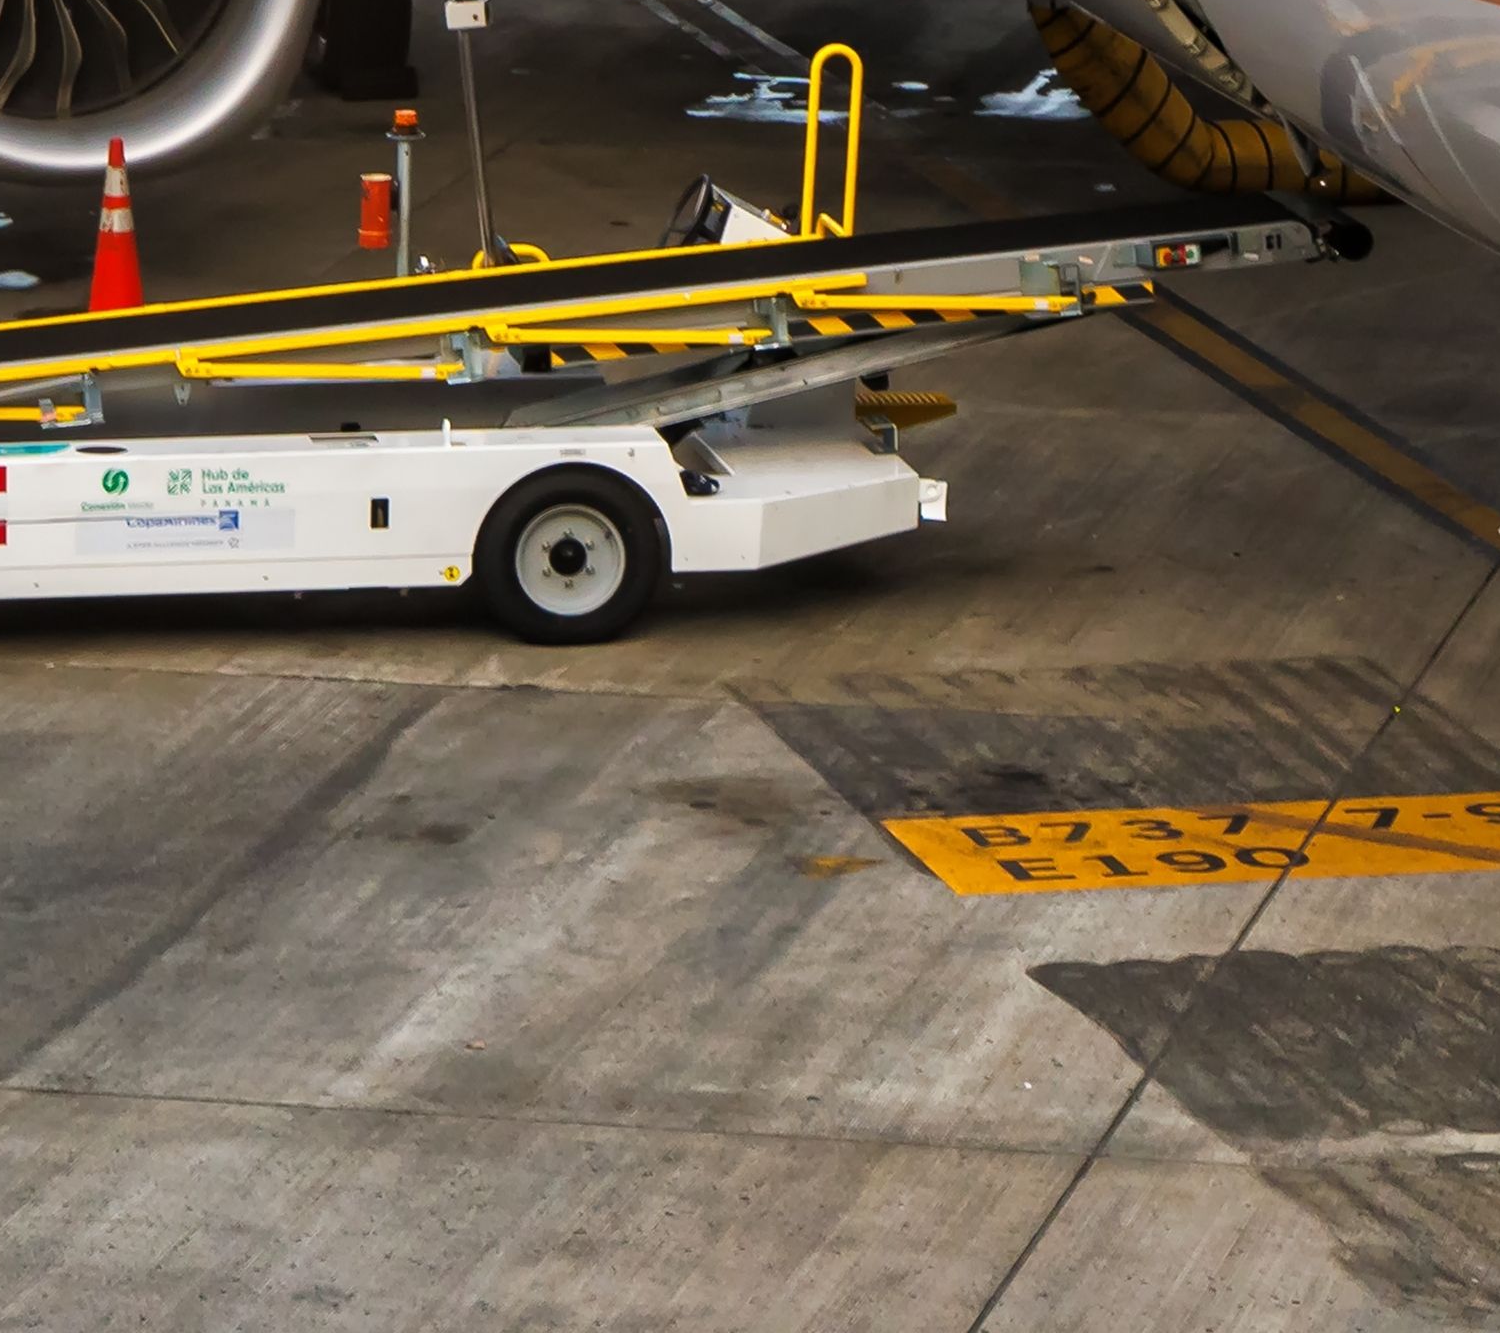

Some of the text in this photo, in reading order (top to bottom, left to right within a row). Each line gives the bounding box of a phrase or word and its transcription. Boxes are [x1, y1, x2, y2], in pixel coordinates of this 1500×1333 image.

[201, 468, 250, 481] Hub de
[961, 812, 1252, 849] B737
[996, 846, 1311, 883] E190
